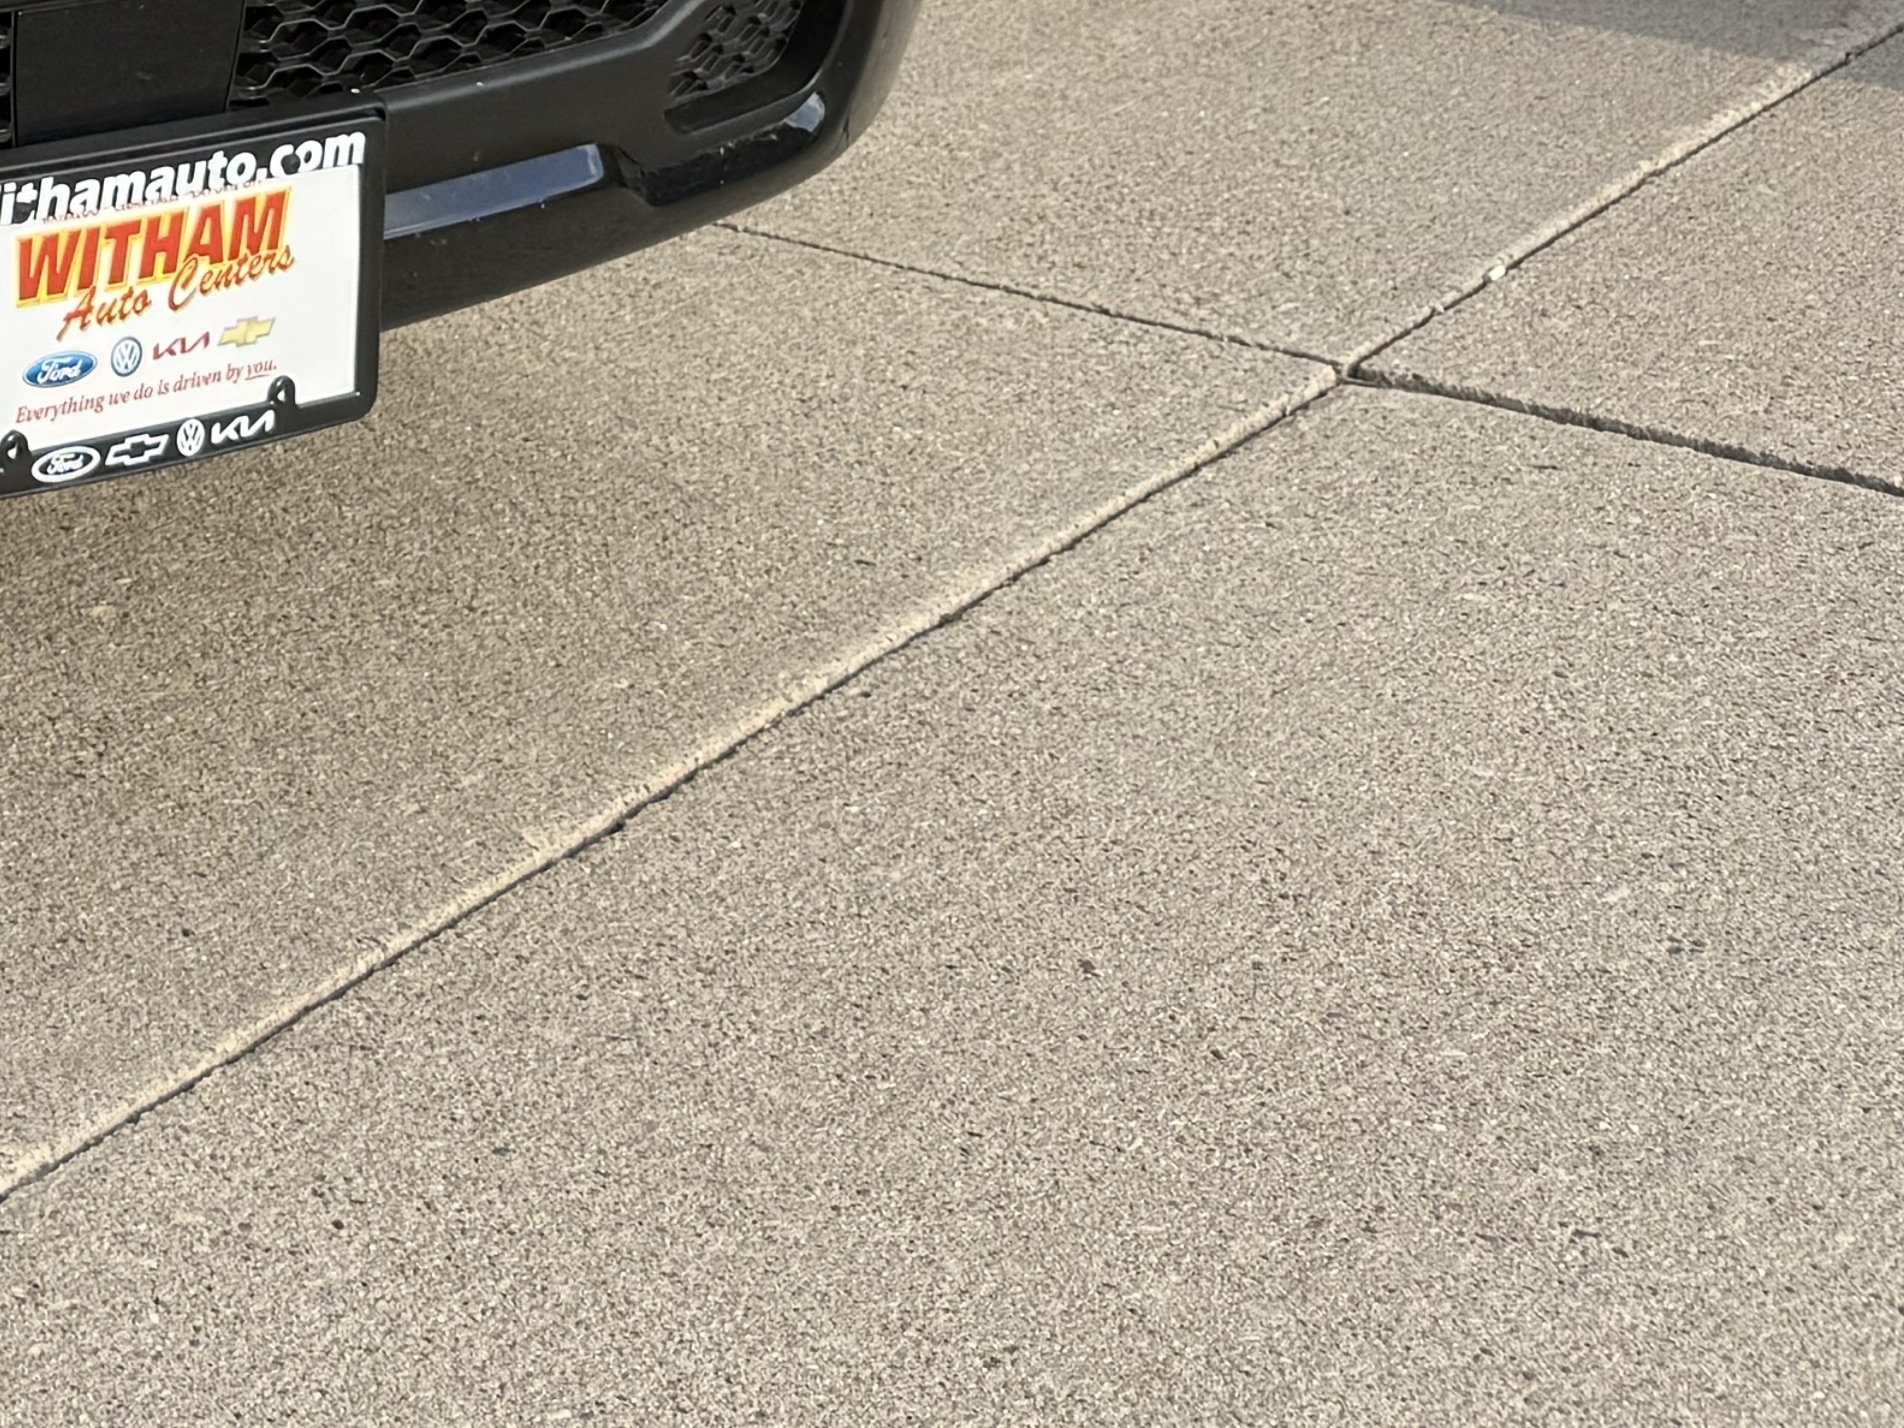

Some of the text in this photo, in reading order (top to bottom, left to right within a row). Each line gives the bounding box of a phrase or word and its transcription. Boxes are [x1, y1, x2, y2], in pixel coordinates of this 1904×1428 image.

[16, 187, 292, 306] WITHAM
[56, 243, 296, 342] Auto Centers
[15, 359, 278, 423] Everything we do is driven by you.
